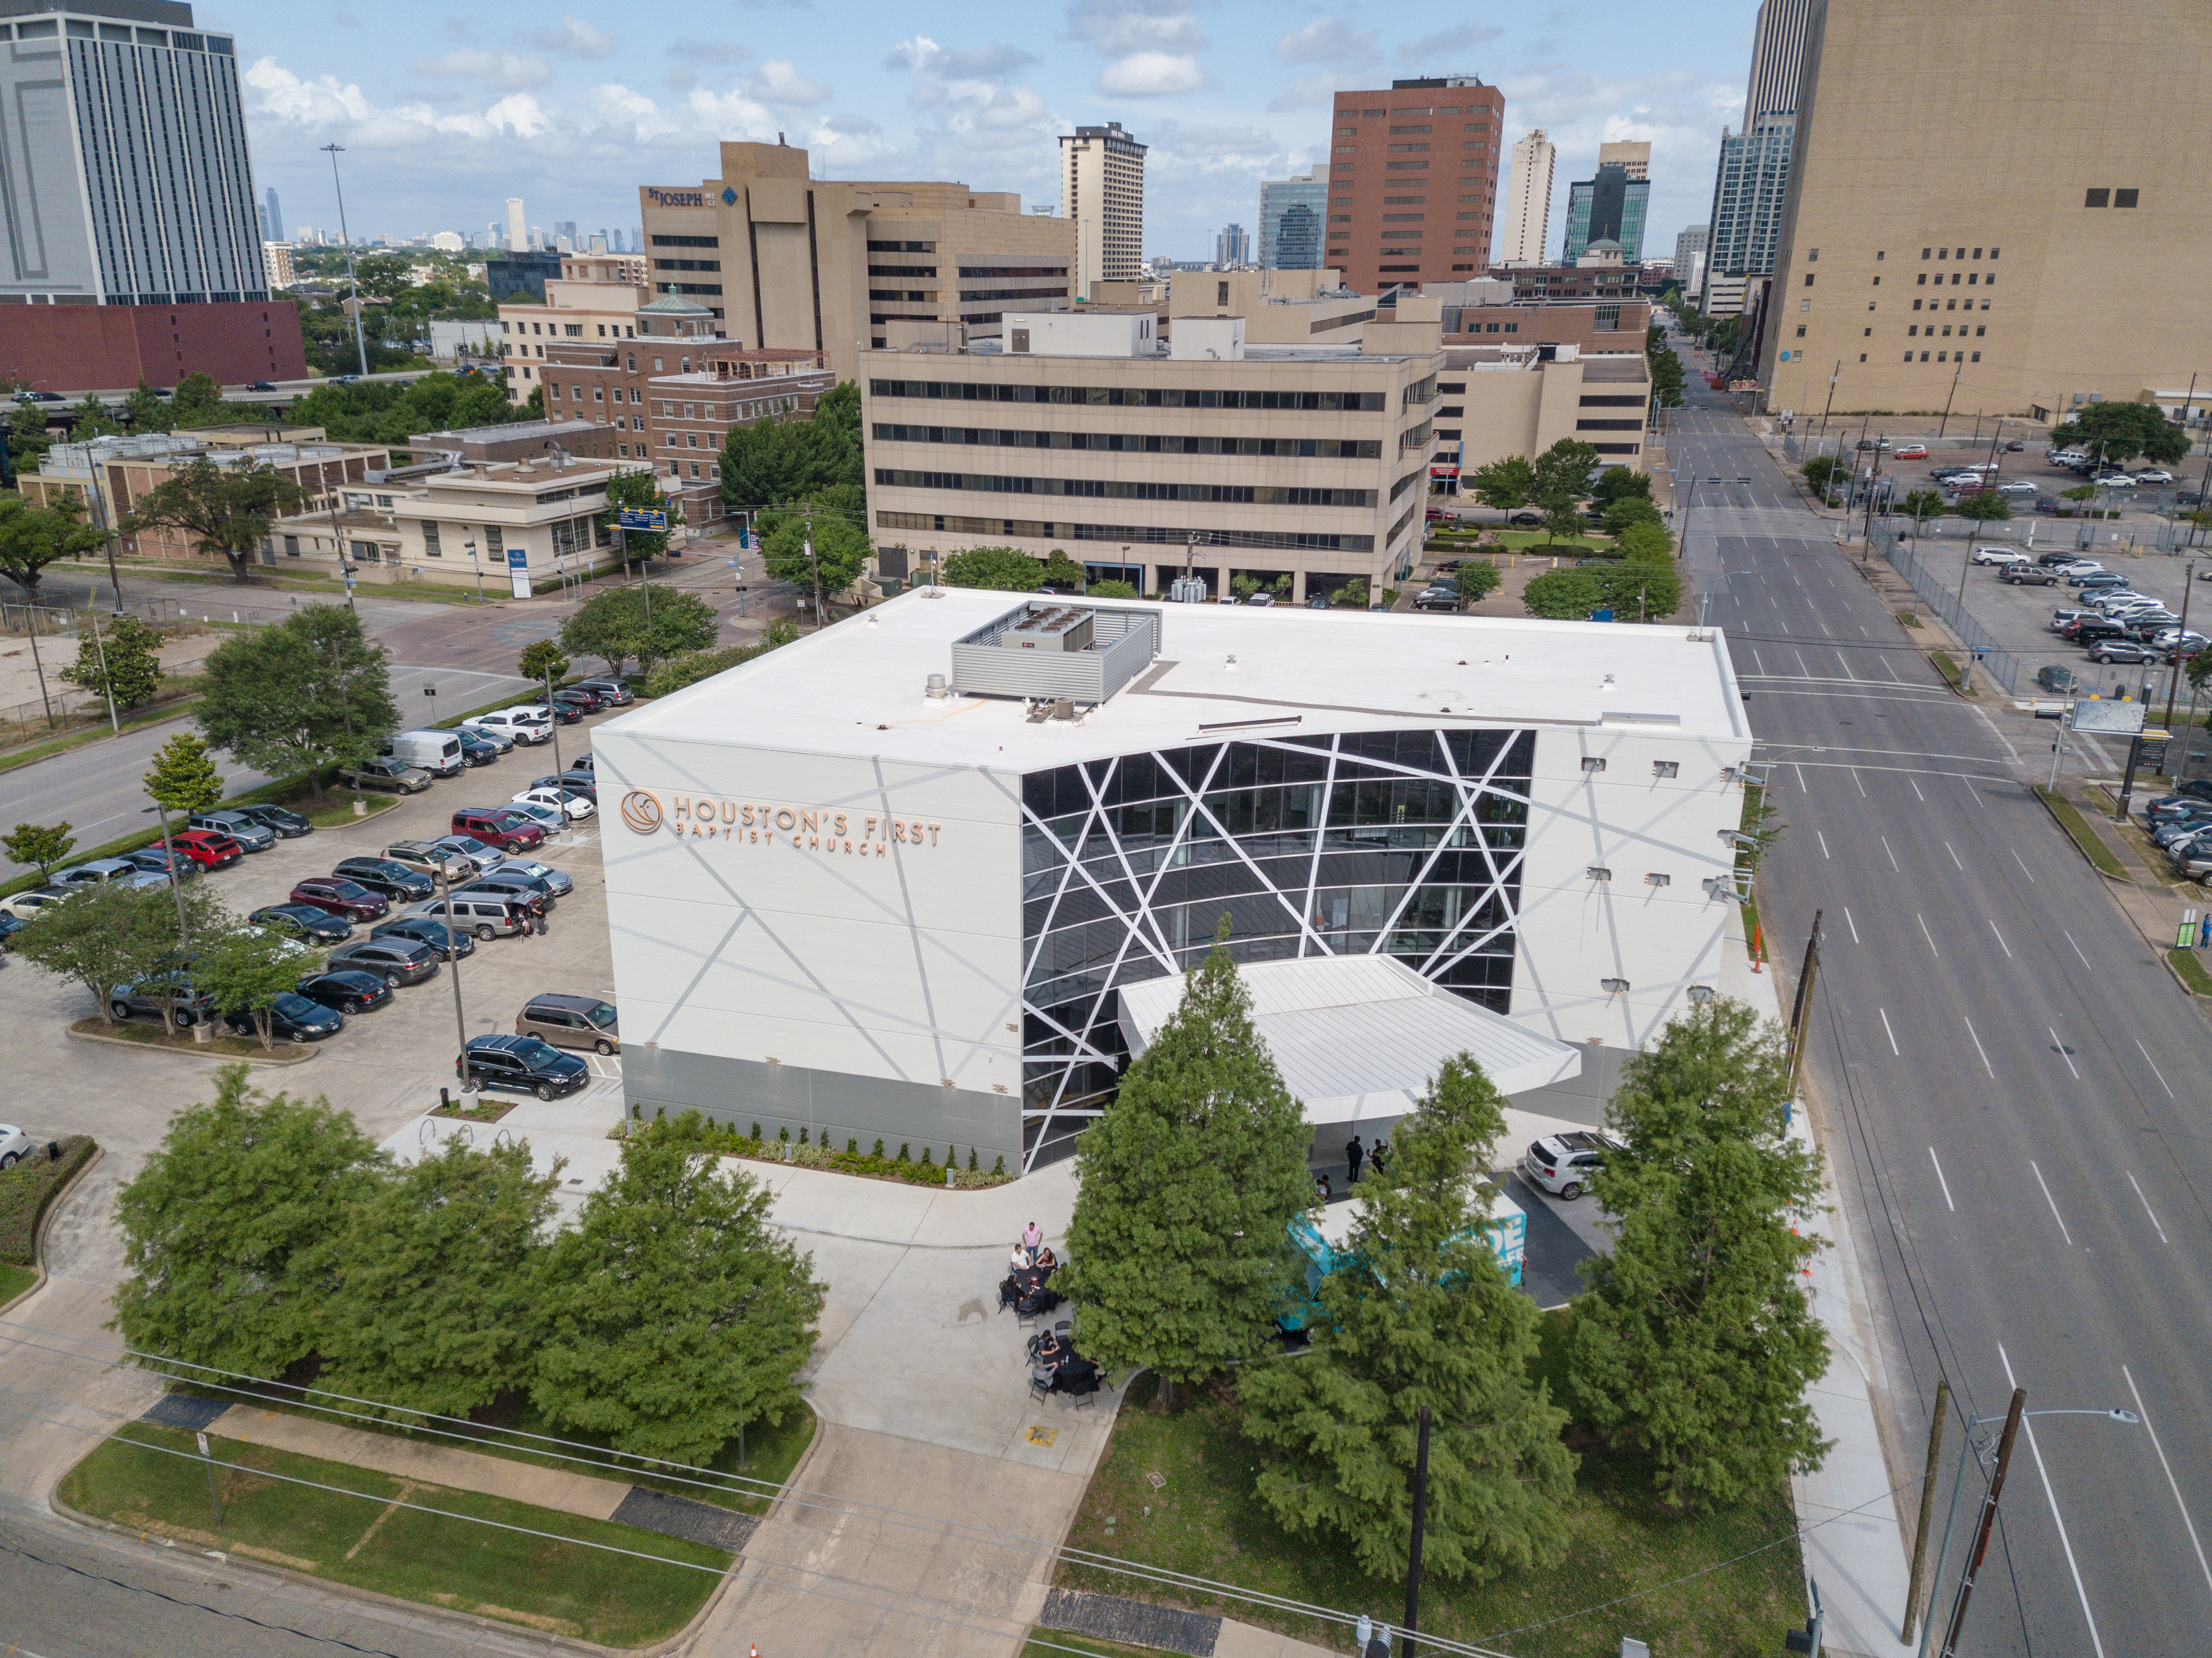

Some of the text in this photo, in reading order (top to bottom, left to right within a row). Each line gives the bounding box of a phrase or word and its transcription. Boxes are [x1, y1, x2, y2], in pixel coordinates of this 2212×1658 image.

[659, 192, 703, 207] JOSEPH
[674, 796, 941, 846] HOUSTON'S FIRST
[675, 822, 886, 857] BAPTIST CHURCH
